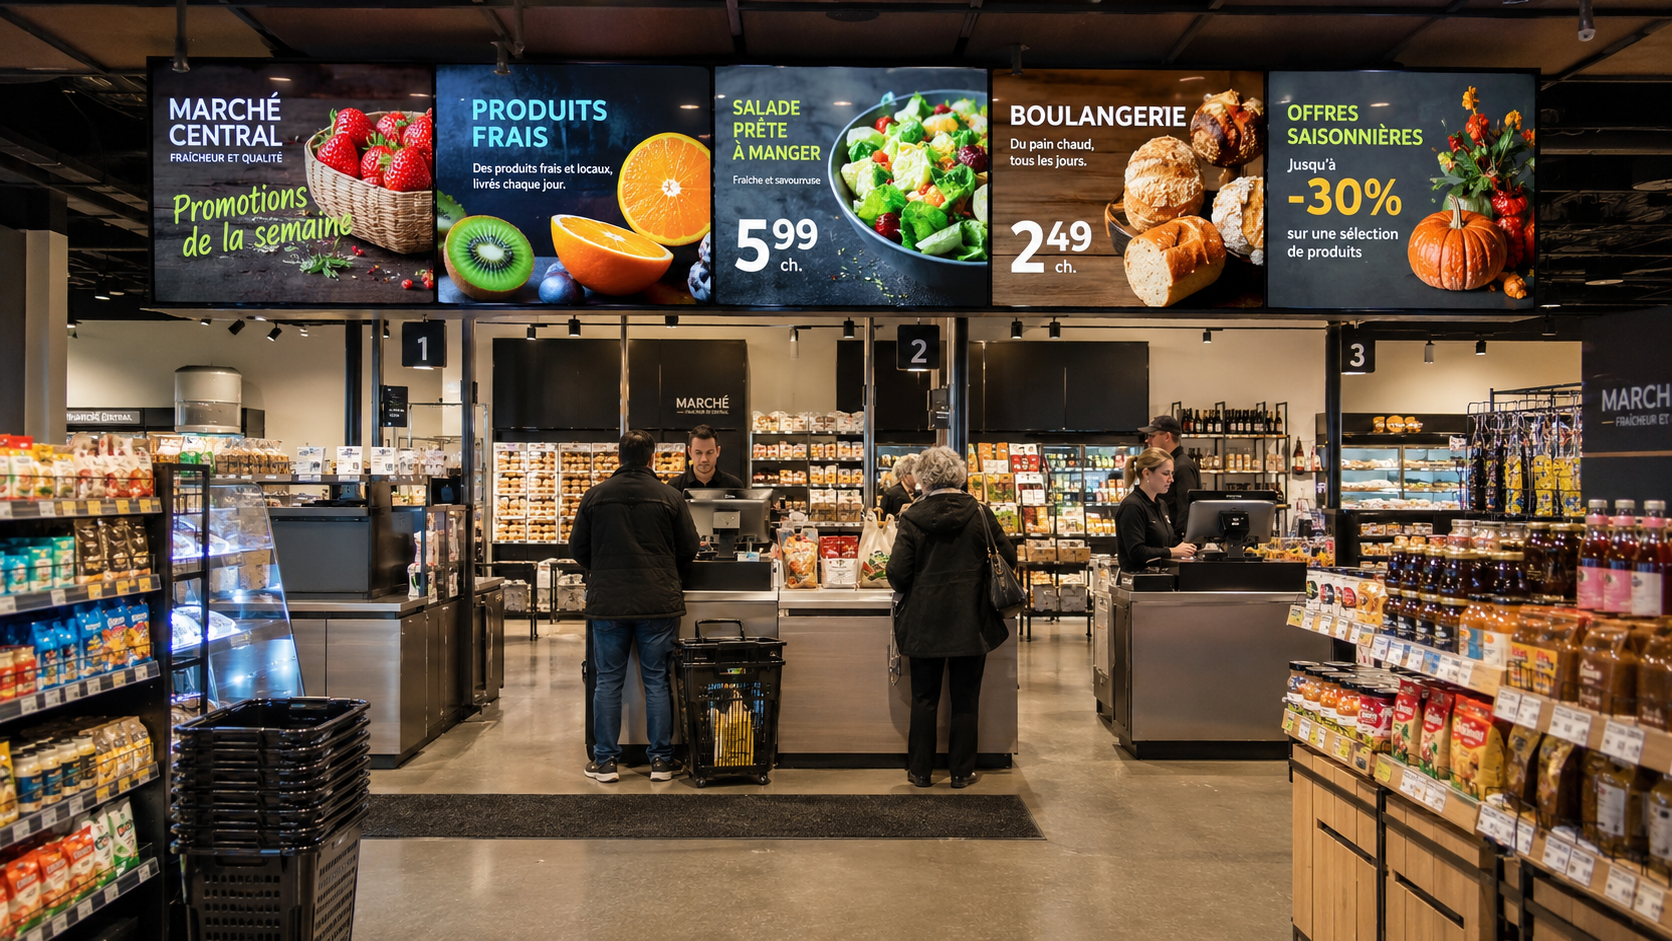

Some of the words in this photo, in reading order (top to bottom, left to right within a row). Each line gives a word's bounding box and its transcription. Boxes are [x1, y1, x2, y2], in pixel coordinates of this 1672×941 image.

[169, 91, 282, 121] MARCHÉ
[472, 98, 608, 122] PRODUITS
[732, 99, 801, 116] SALADE
[1010, 105, 1187, 127] BOULANGERIE
[1287, 103, 1359, 122] OFFRES
[169, 124, 283, 147] CENTRAL
[472, 126, 548, 148] FRAIS
[733, 117, 788, 139] PRÊTE
[1287, 123, 1424, 146] SAISONNIÈRES
[732, 140, 745, 161] À
[749, 144, 821, 161] MANGER
[1010, 138, 1026, 150] Du
[1029, 138, 1054, 153] pain
[1056, 138, 1095, 152] chaud,
[227, 153, 240, 163] ET
[1009, 155, 1035, 166] tous
[1037, 154, 1054, 166] les
[1054, 155, 1087, 169] jours.
[473, 163, 493, 174] Des
[494, 163, 537, 176] produits
[539, 163, 562, 174] frais
[564, 165, 575, 174] et
[577, 163, 613, 176] locaux,
[473, 177, 501, 190] livrés
[502, 178, 541, 192] chaque
[541, 179, 566, 192] jour.
[764, 176, 774, 185] et
[173, 184, 307, 224] Promotions
[1287, 177, 1403, 216] -30%
[182, 226, 212, 258] de
[223, 221, 244, 253] la
[253, 211, 352, 249] semaine
[1287, 229, 1307, 240] sur
[1311, 229, 1337, 240] une
[1339, 227, 1399, 240] sélection
[1287, 245, 1304, 258] de
[1307, 245, 1363, 260] produits
[780, 257, 803, 272] ch.
[1054, 259, 1077, 274] ch.
[416, 336, 429, 362] 1
[910, 338, 928, 364] 2
[1349, 342, 1366, 368] 3
[676, 394, 730, 409] MARCHÉ
[1658, 413, 1670, 425] ET
